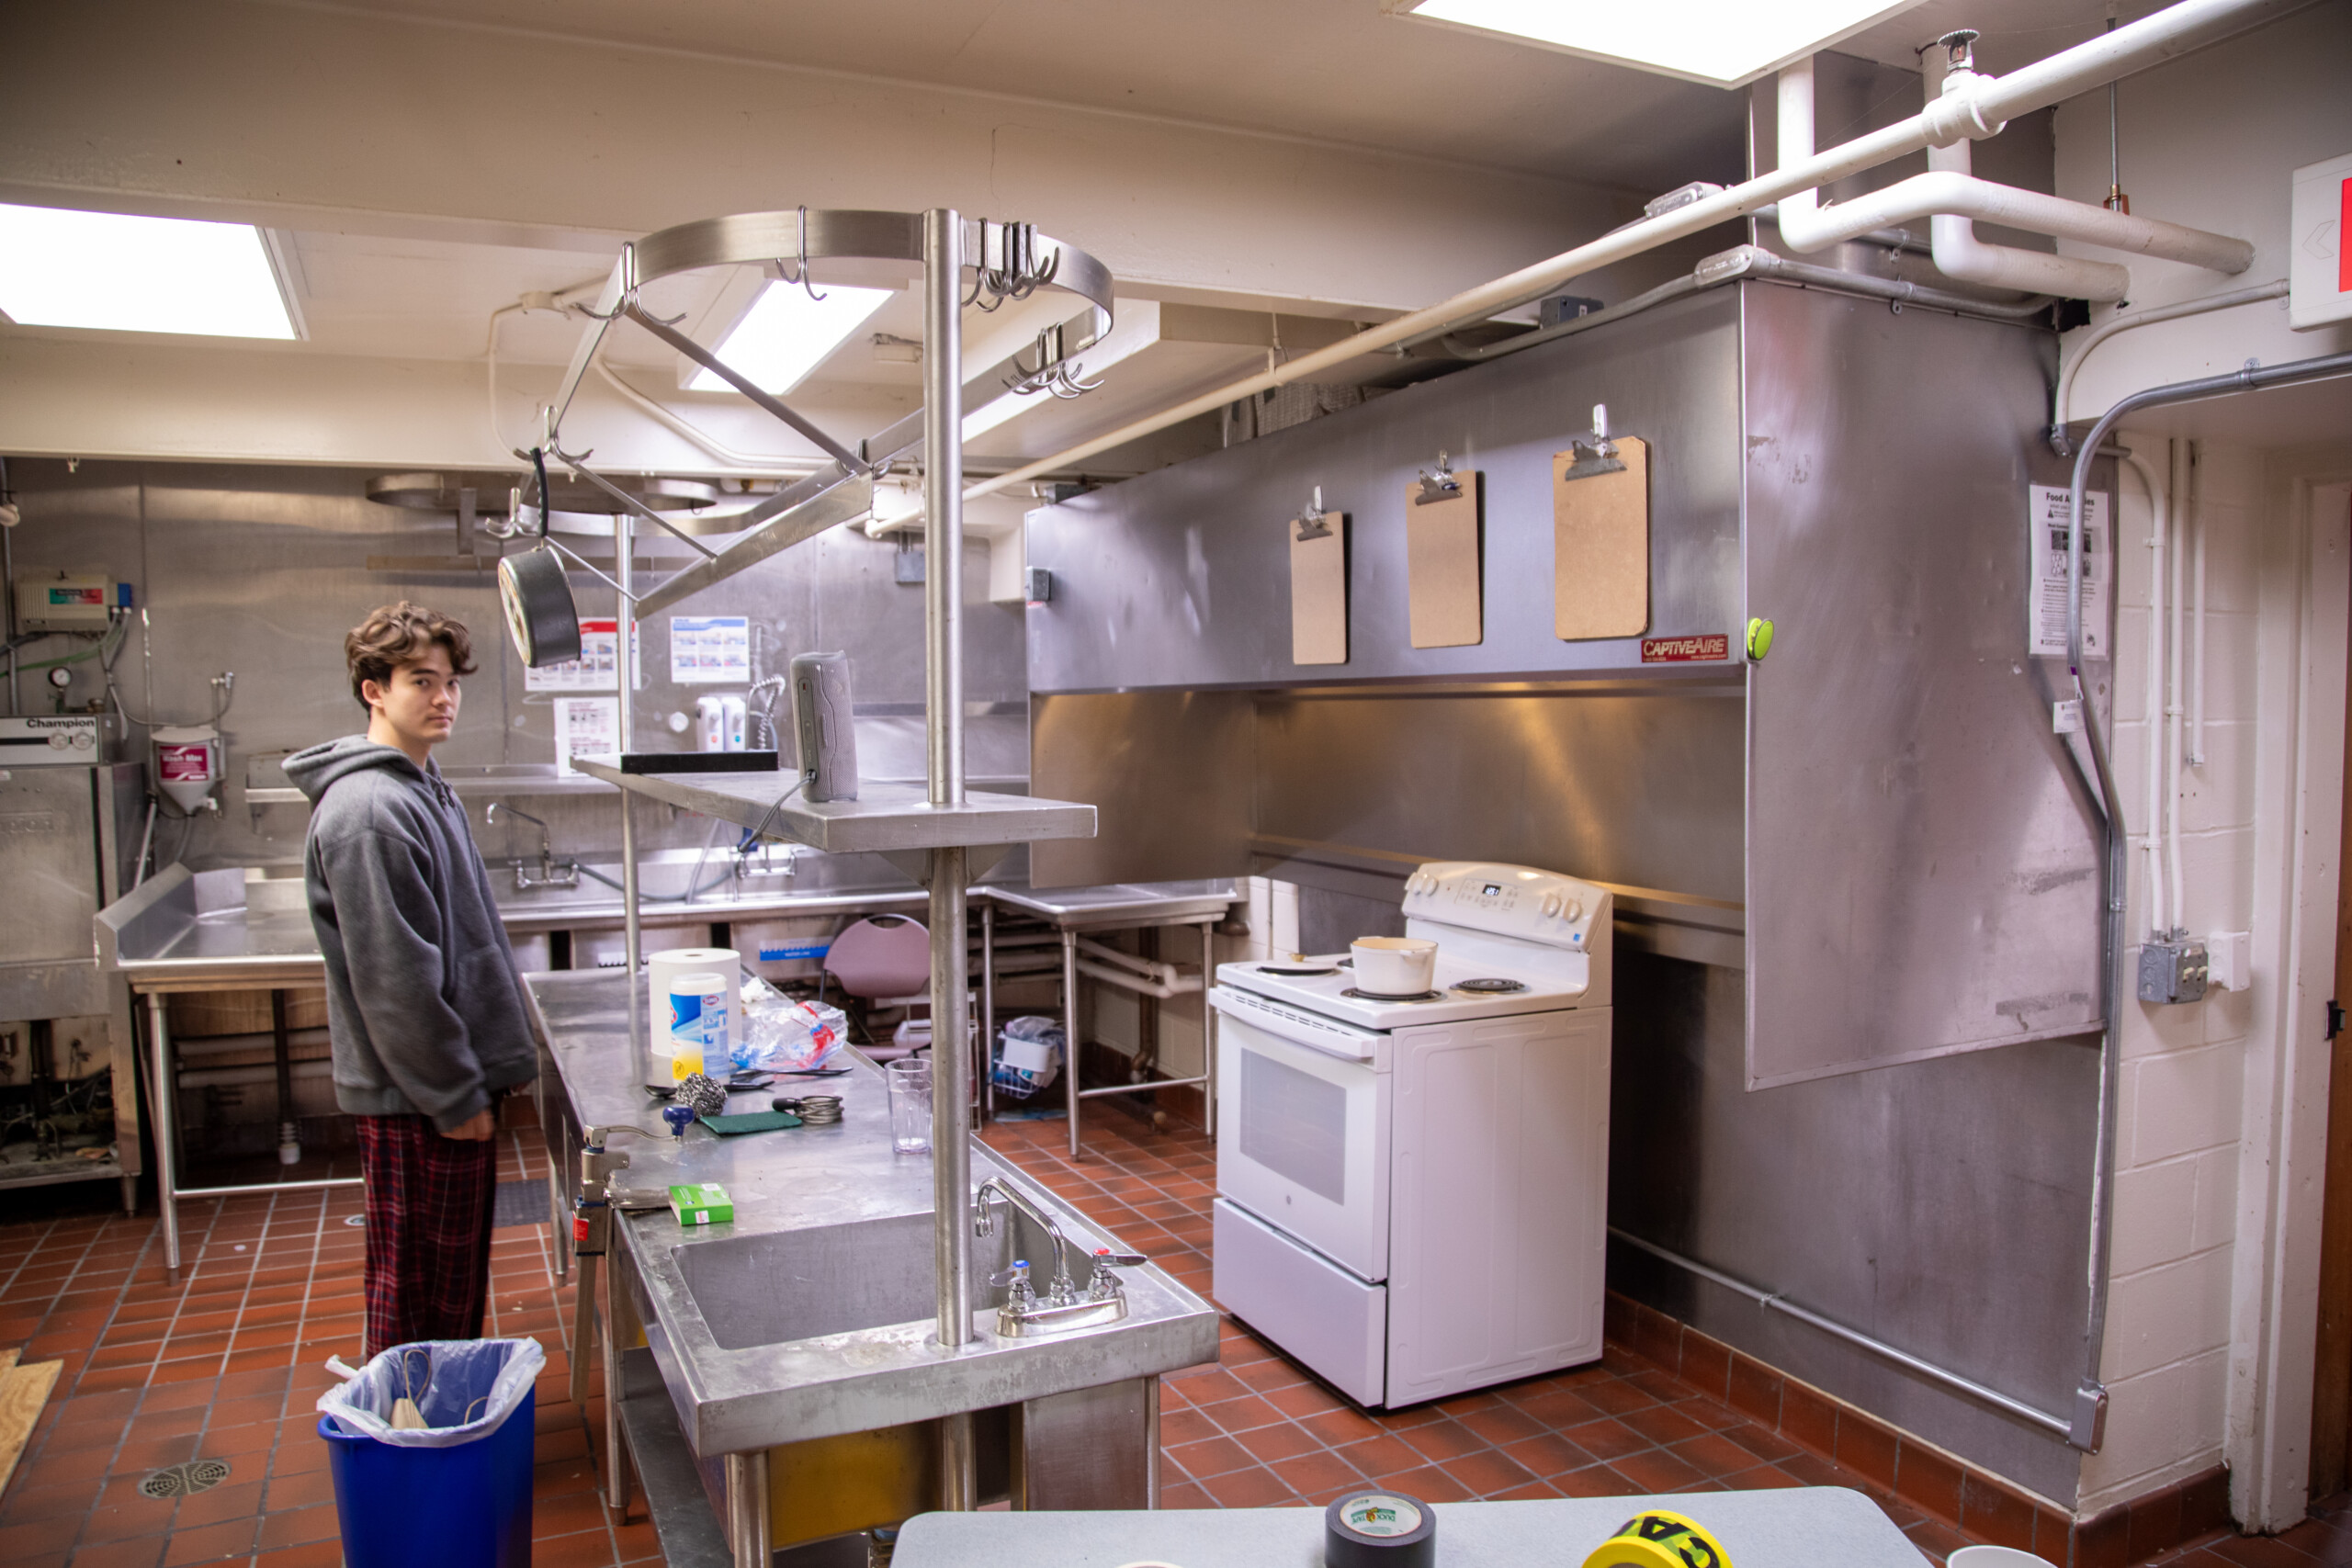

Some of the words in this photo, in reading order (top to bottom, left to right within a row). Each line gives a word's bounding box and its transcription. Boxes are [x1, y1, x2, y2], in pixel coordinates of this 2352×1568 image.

[2046, 492, 2063, 502] Food
[27, 718, 95, 728] Champion
[1376, 1514, 1396, 1522] DUCK
